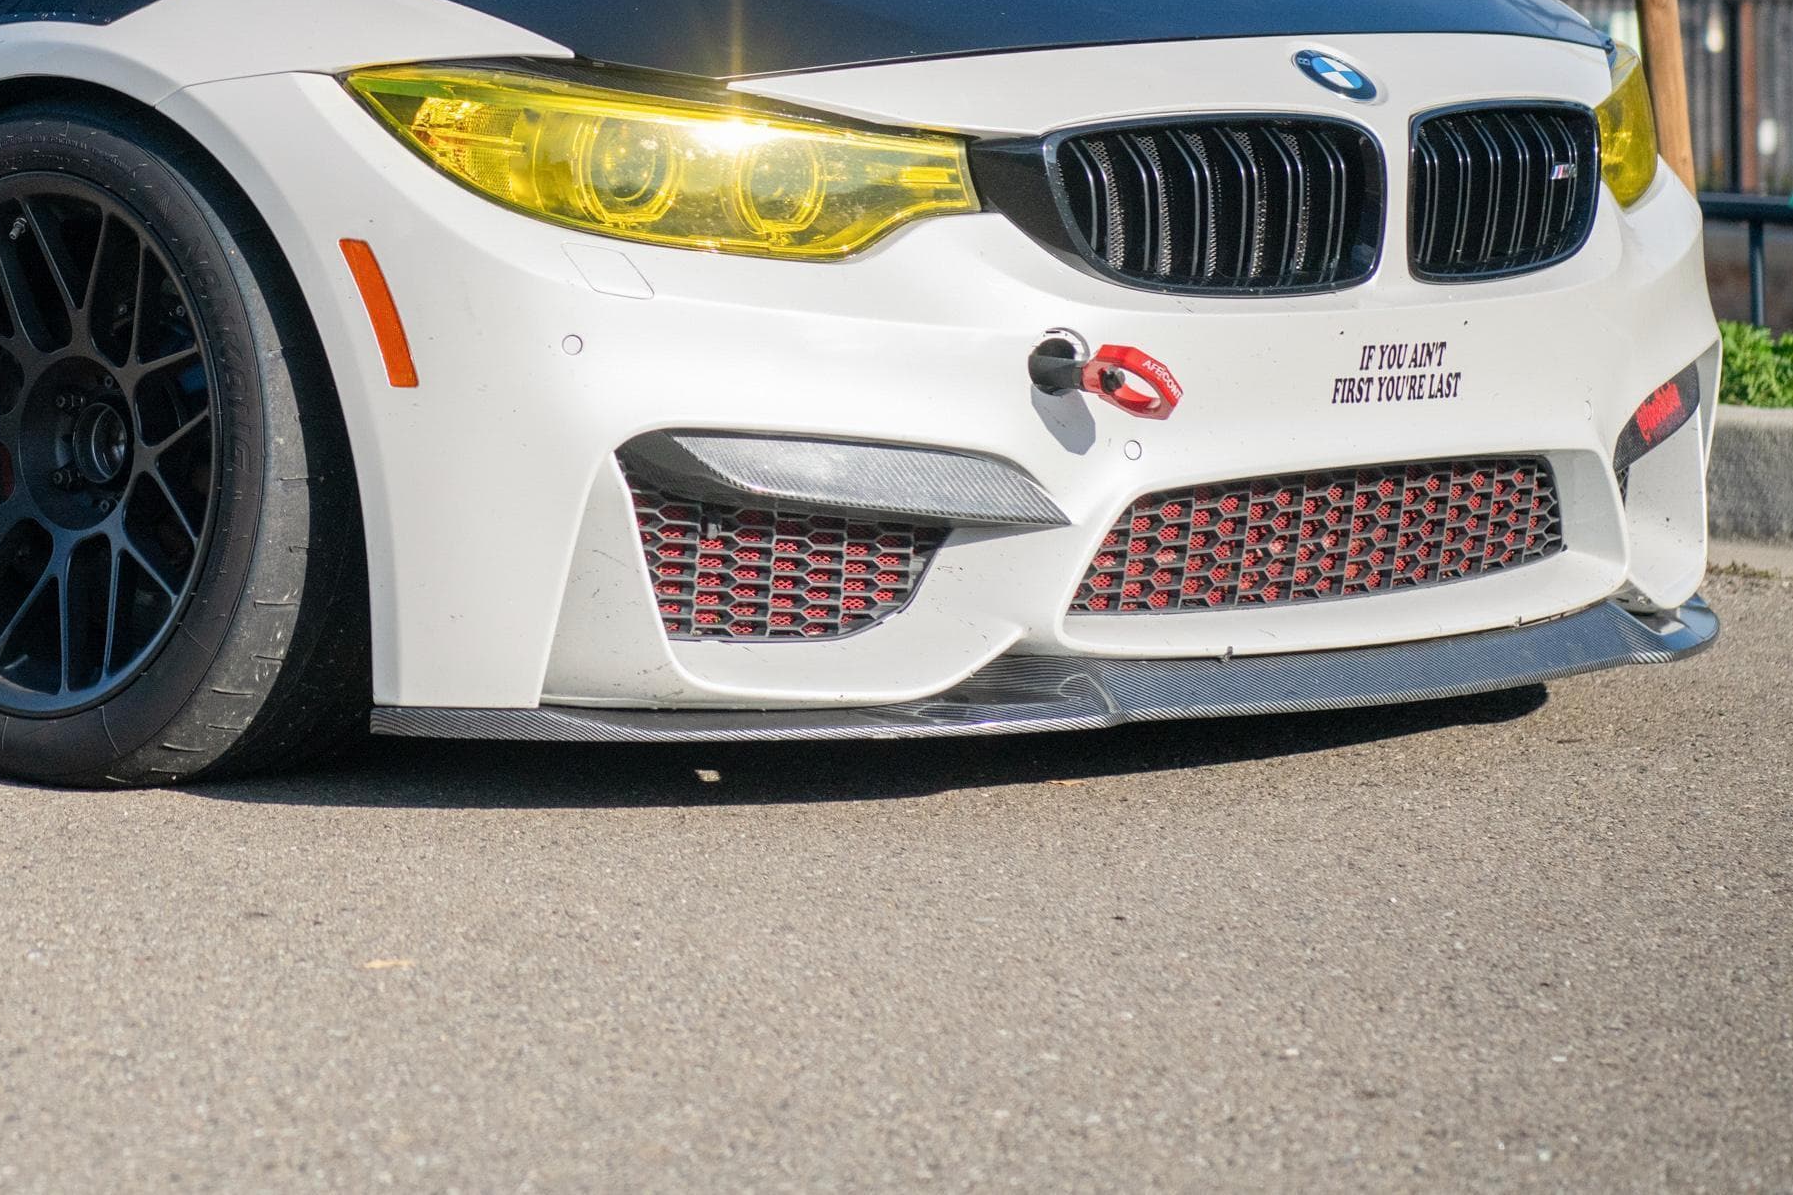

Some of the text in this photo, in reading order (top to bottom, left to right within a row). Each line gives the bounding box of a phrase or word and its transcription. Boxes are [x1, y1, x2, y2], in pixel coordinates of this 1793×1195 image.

[1359, 341, 1447, 371] IF YOU AIN'T
[1331, 372, 1461, 404] FIRST YOU'RE LAST
